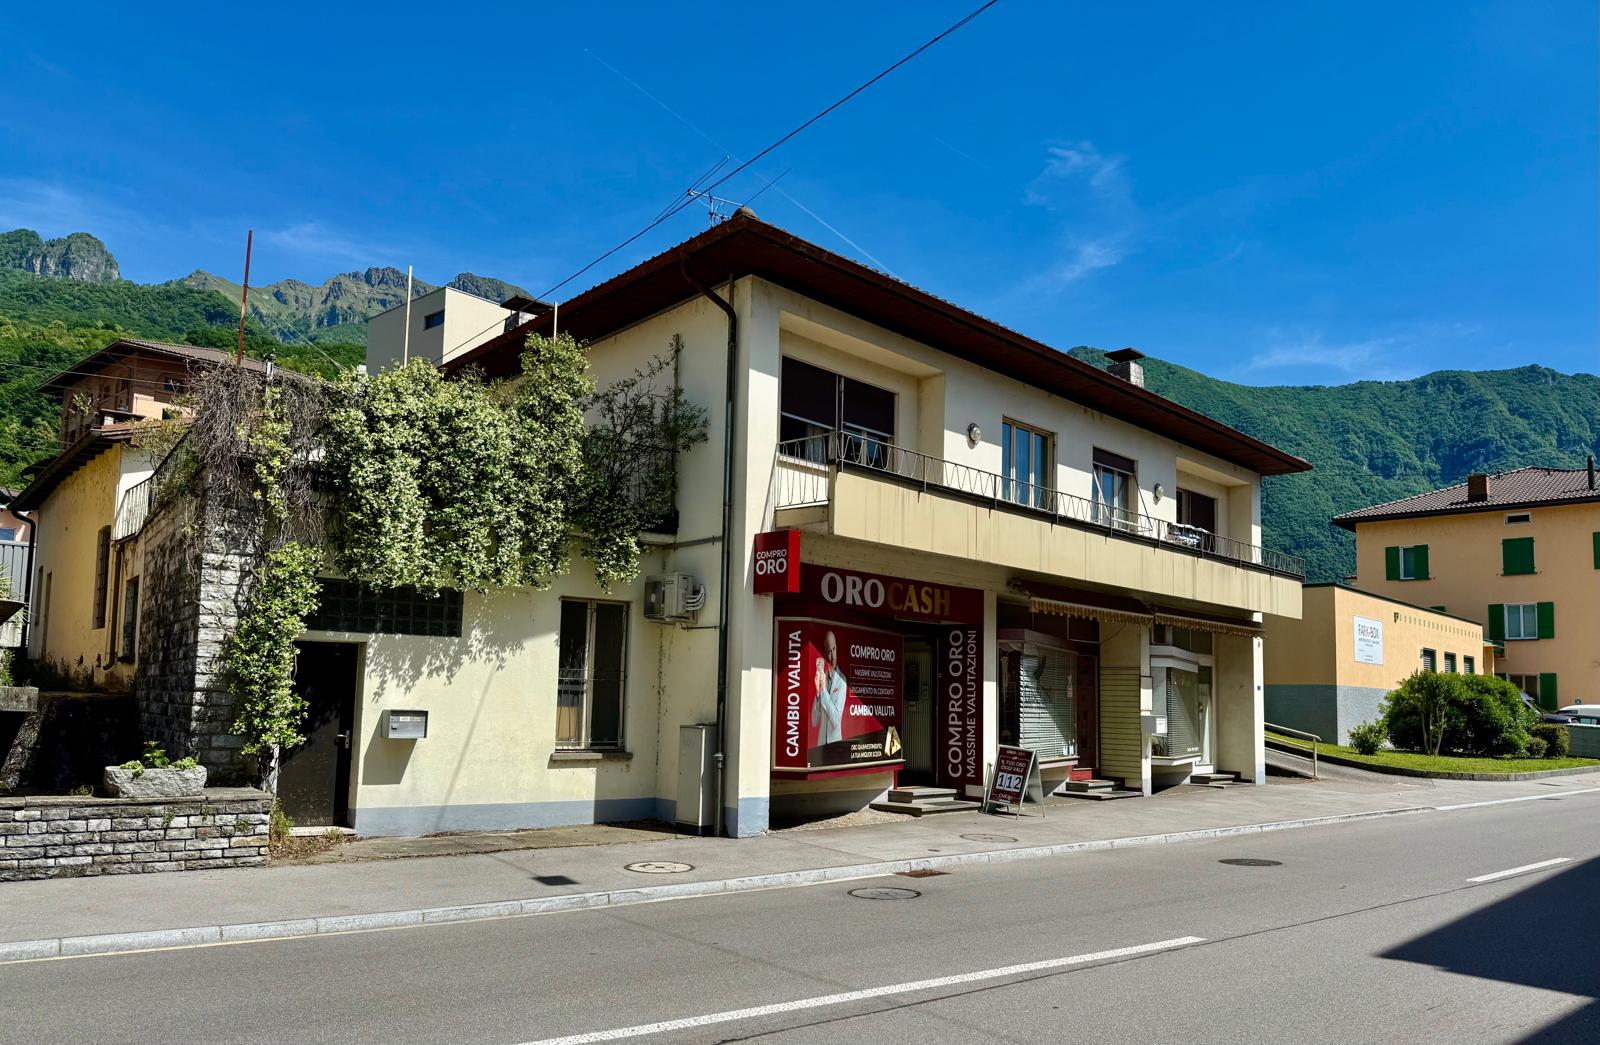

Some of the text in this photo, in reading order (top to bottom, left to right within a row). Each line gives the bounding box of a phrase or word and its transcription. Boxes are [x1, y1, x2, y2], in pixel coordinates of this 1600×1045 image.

[756, 549, 787, 560] COMPRO
[756, 558, 787, 576] ORO
[850, 644, 895, 662] COMPRO ORO
[786, 630, 801, 757] CAMBIO VALUTA
[850, 704, 895, 716] CAMBIO VALUTA
[948, 630, 963, 778] COMPRO ORO
[967, 630, 977, 778] MASSIME VALUTAZIONI
[998, 775, 1022, 790] 112
